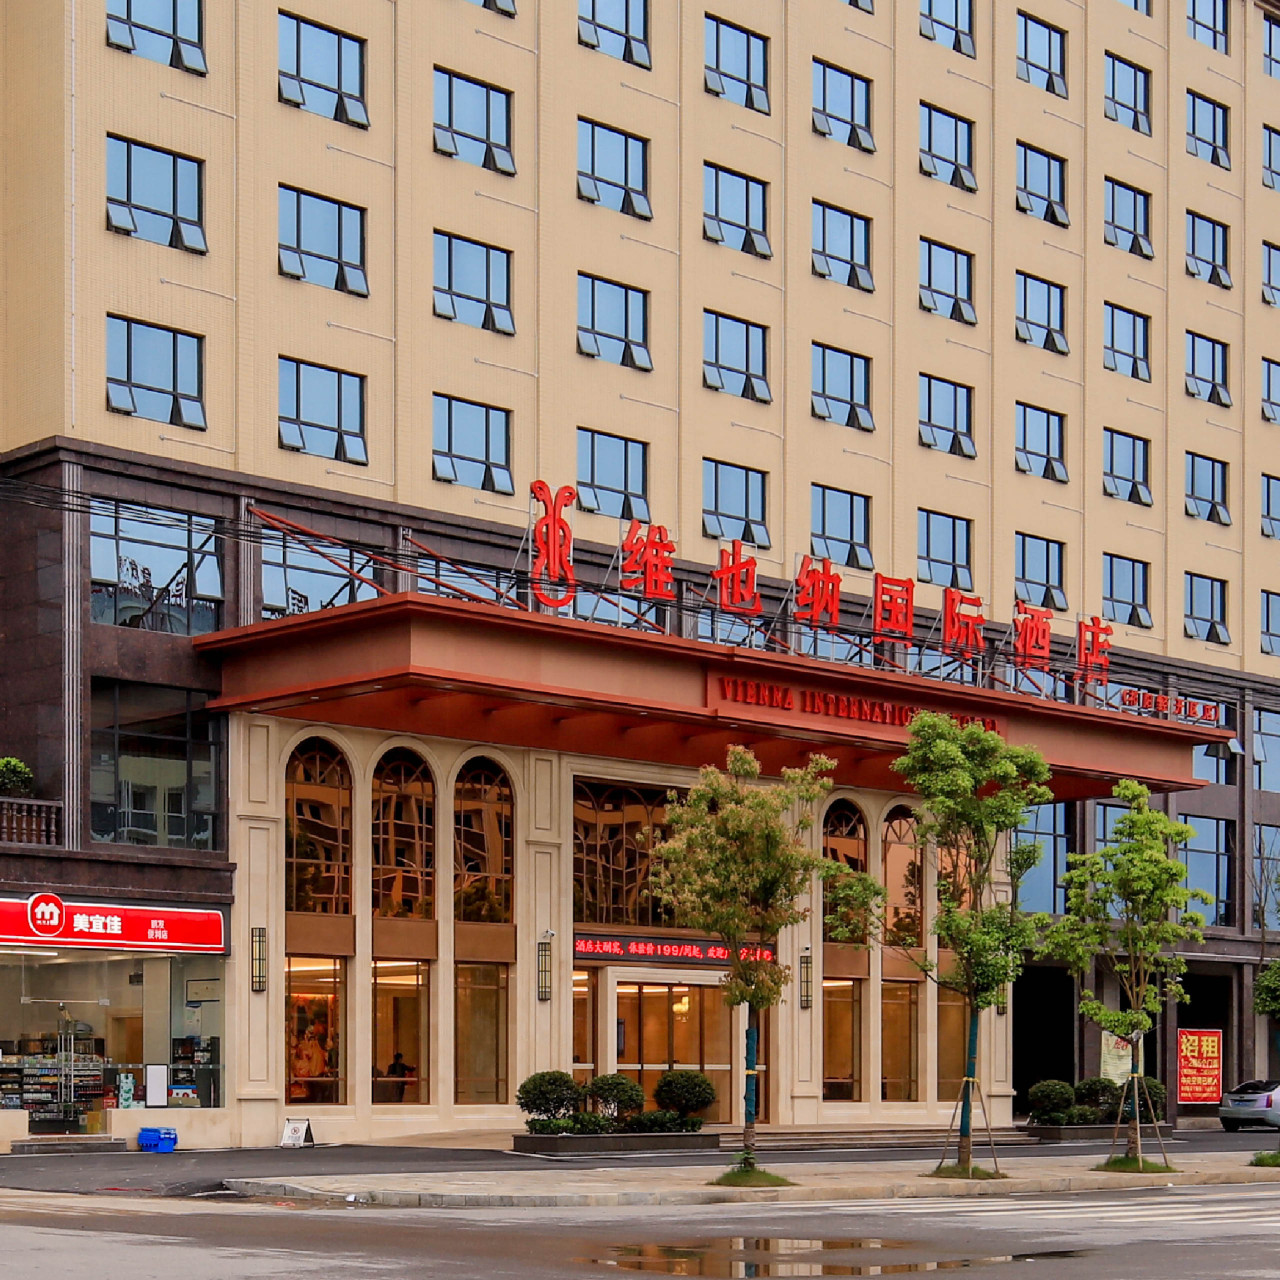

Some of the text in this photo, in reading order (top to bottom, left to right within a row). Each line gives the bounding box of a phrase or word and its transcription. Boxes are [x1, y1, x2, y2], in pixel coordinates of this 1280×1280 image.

[621, 519, 1114, 687] 维也纳国际酒店
[721, 677, 795, 710] VIENNA
[73, 913, 122, 934] 美宜佳
[1181, 1035, 1219, 1058] 招租
